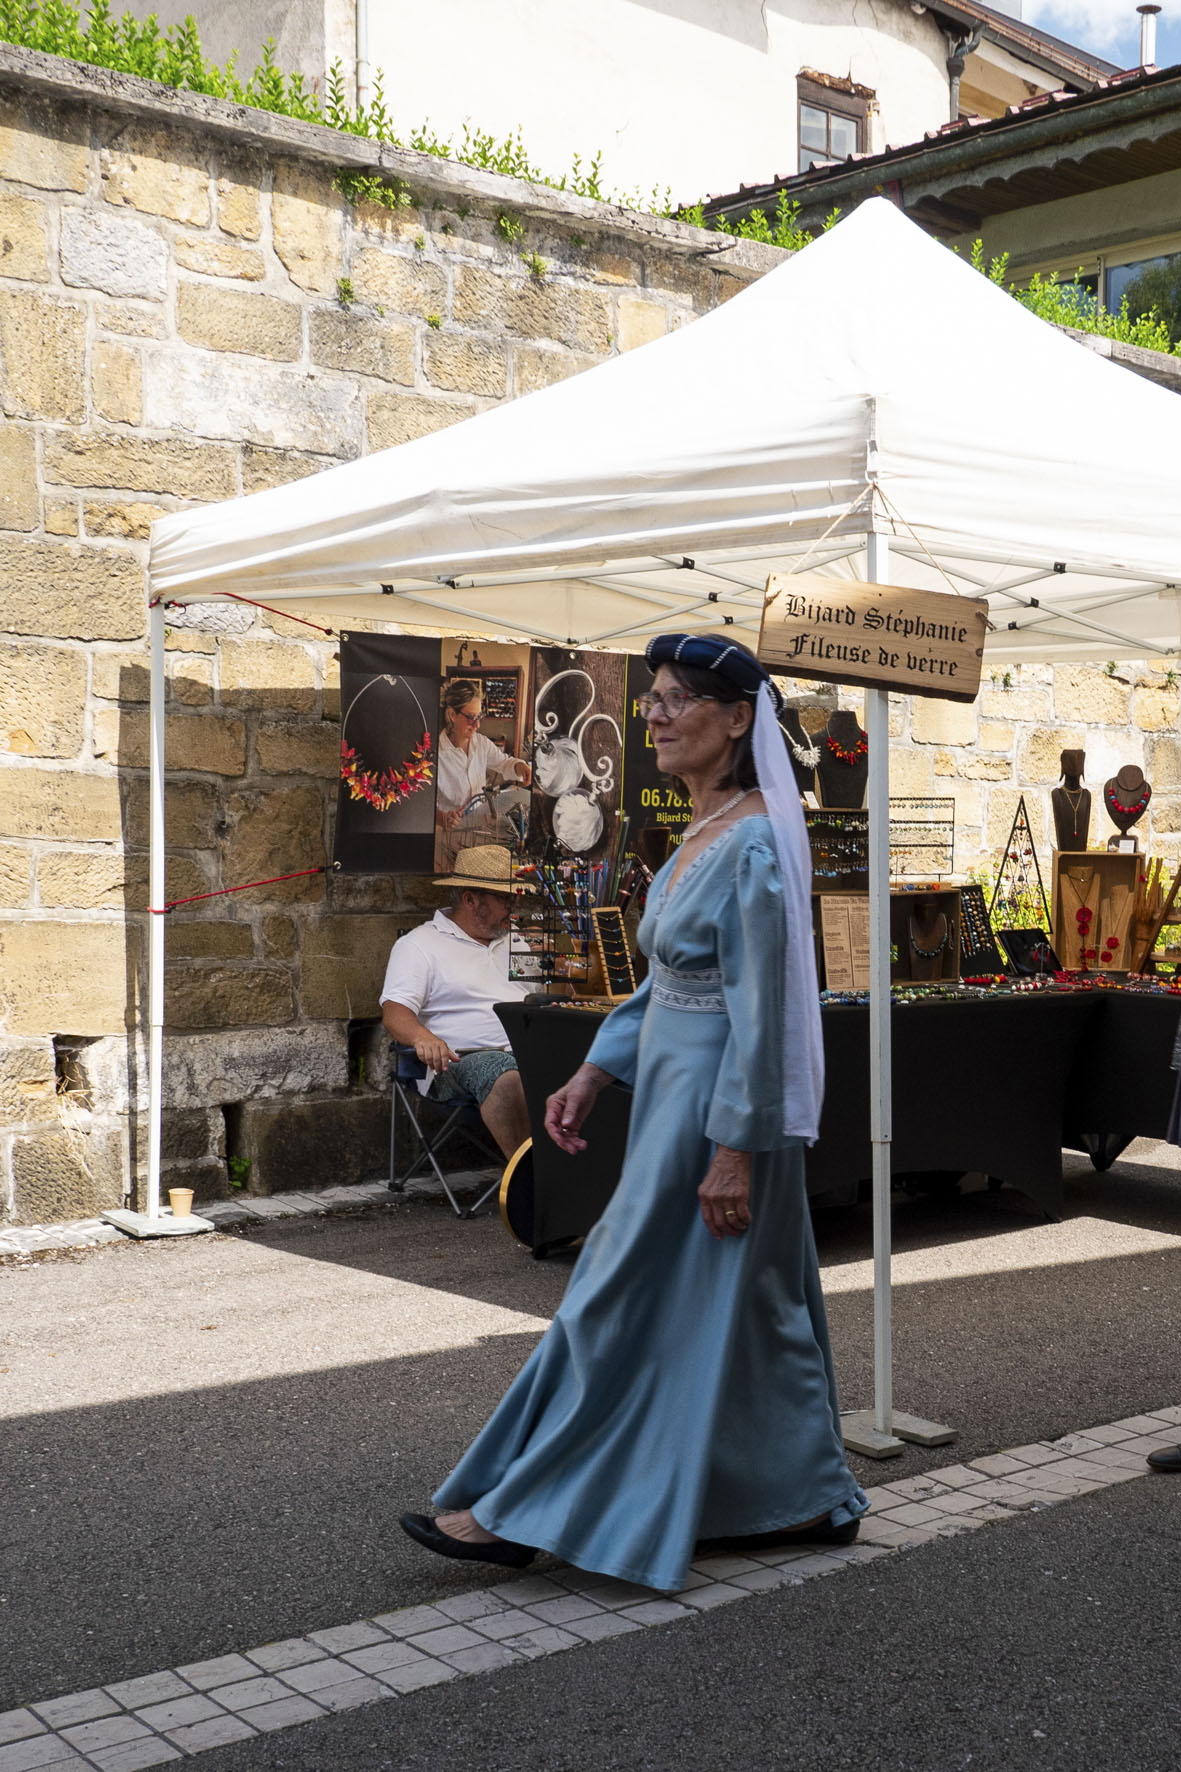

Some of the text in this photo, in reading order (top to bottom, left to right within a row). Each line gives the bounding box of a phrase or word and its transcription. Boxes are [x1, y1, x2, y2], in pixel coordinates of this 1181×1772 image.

[784, 593, 968, 643] Bijard Stéphanie
[785, 633, 959, 677] Fileuse de verre
[656, 812, 681, 824] Bijard
